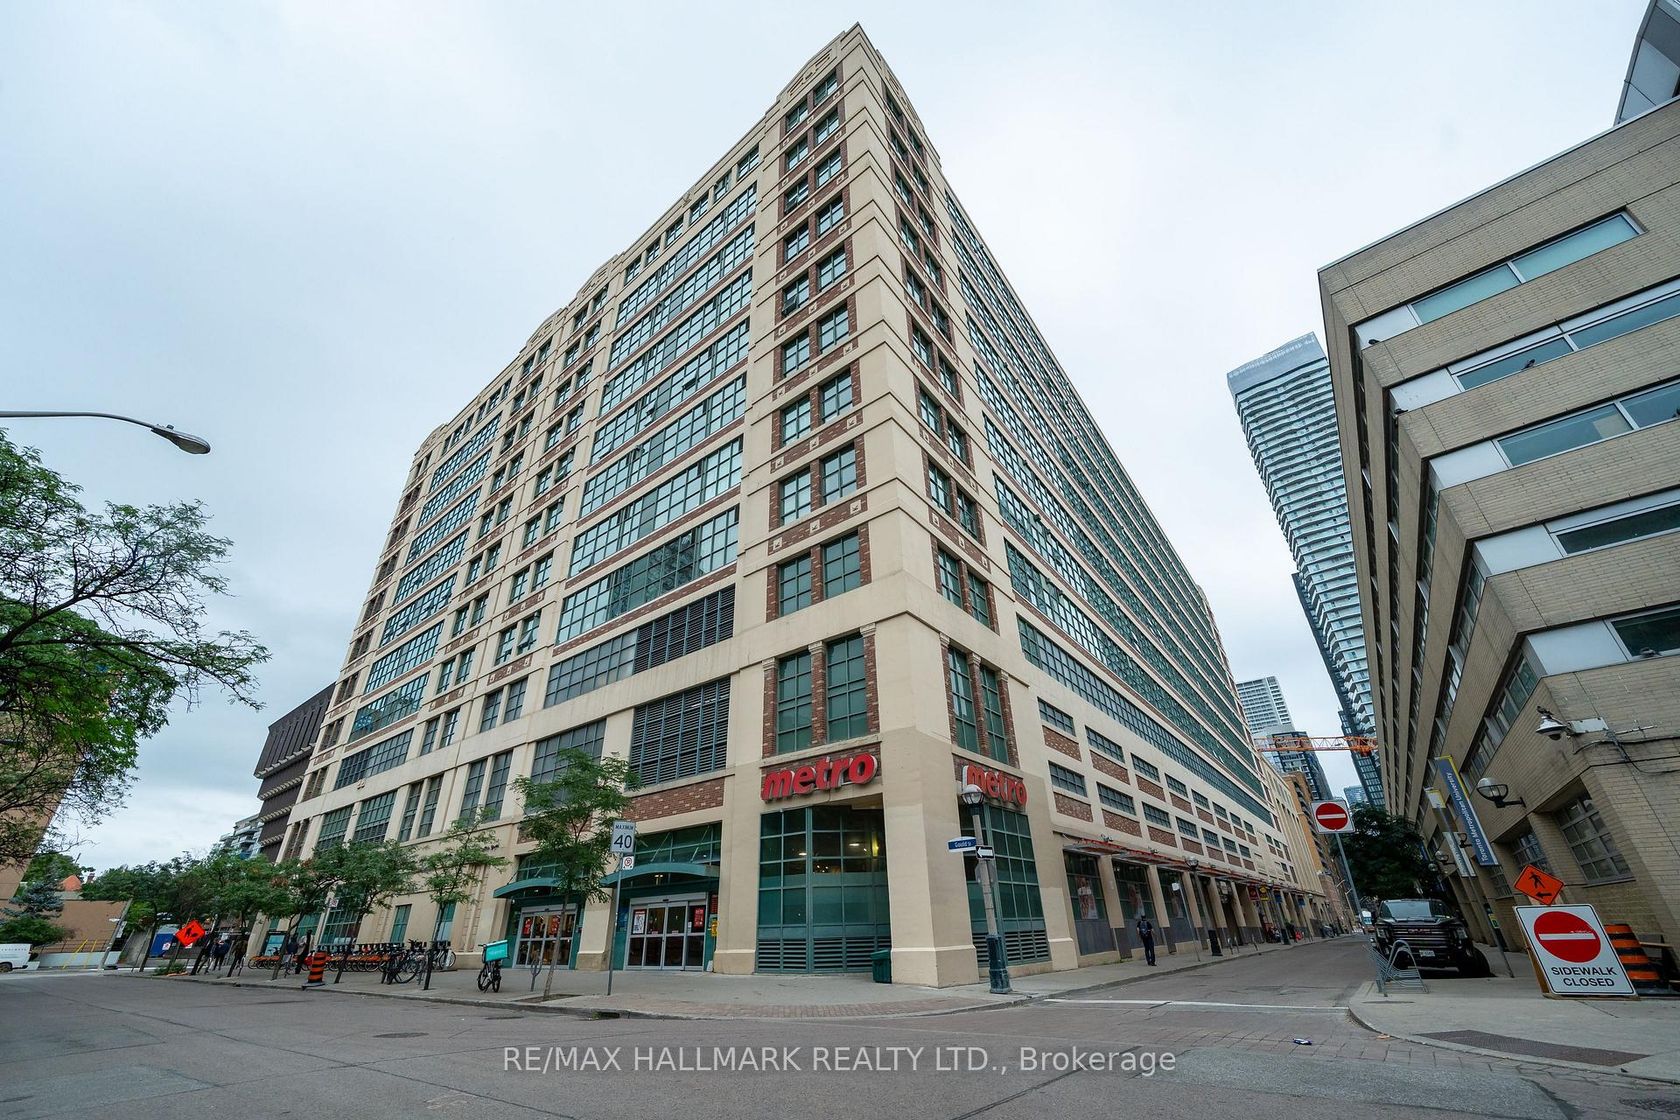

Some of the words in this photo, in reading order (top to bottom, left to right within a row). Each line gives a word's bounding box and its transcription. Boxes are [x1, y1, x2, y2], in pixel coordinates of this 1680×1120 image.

[760, 752, 878, 802] metro
[963, 763, 1028, 806] metro
[1446, 772, 1462, 801] University
[1459, 800, 1478, 838] Metropolitan
[613, 834, 632, 848] 40
[1474, 837, 1489, 862] Toronto
[1551, 966, 1617, 976] SIDEWALK
[1562, 977, 1615, 987] CLOSED
